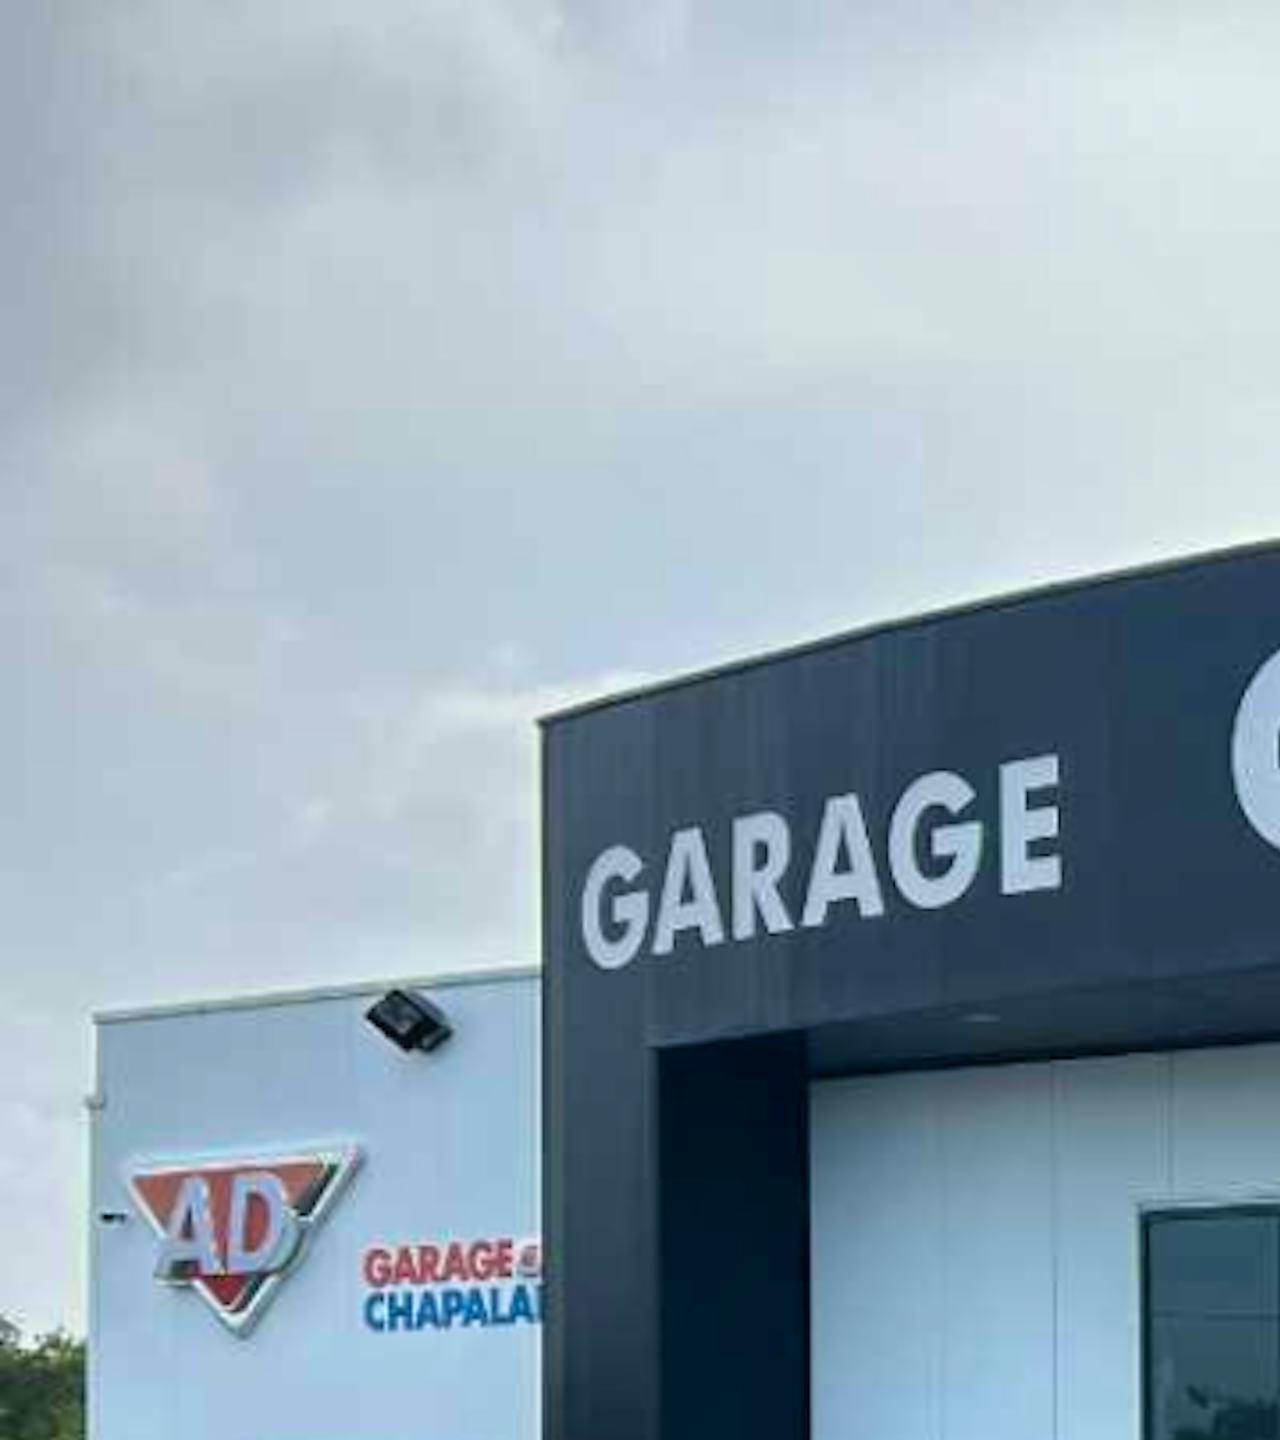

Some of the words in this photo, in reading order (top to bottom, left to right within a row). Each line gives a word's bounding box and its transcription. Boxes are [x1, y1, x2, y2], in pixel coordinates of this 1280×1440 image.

[581, 754, 1062, 970] GARAGE
[155, 1172, 292, 1276] AD
[364, 1239, 513, 1287] GARAGE
